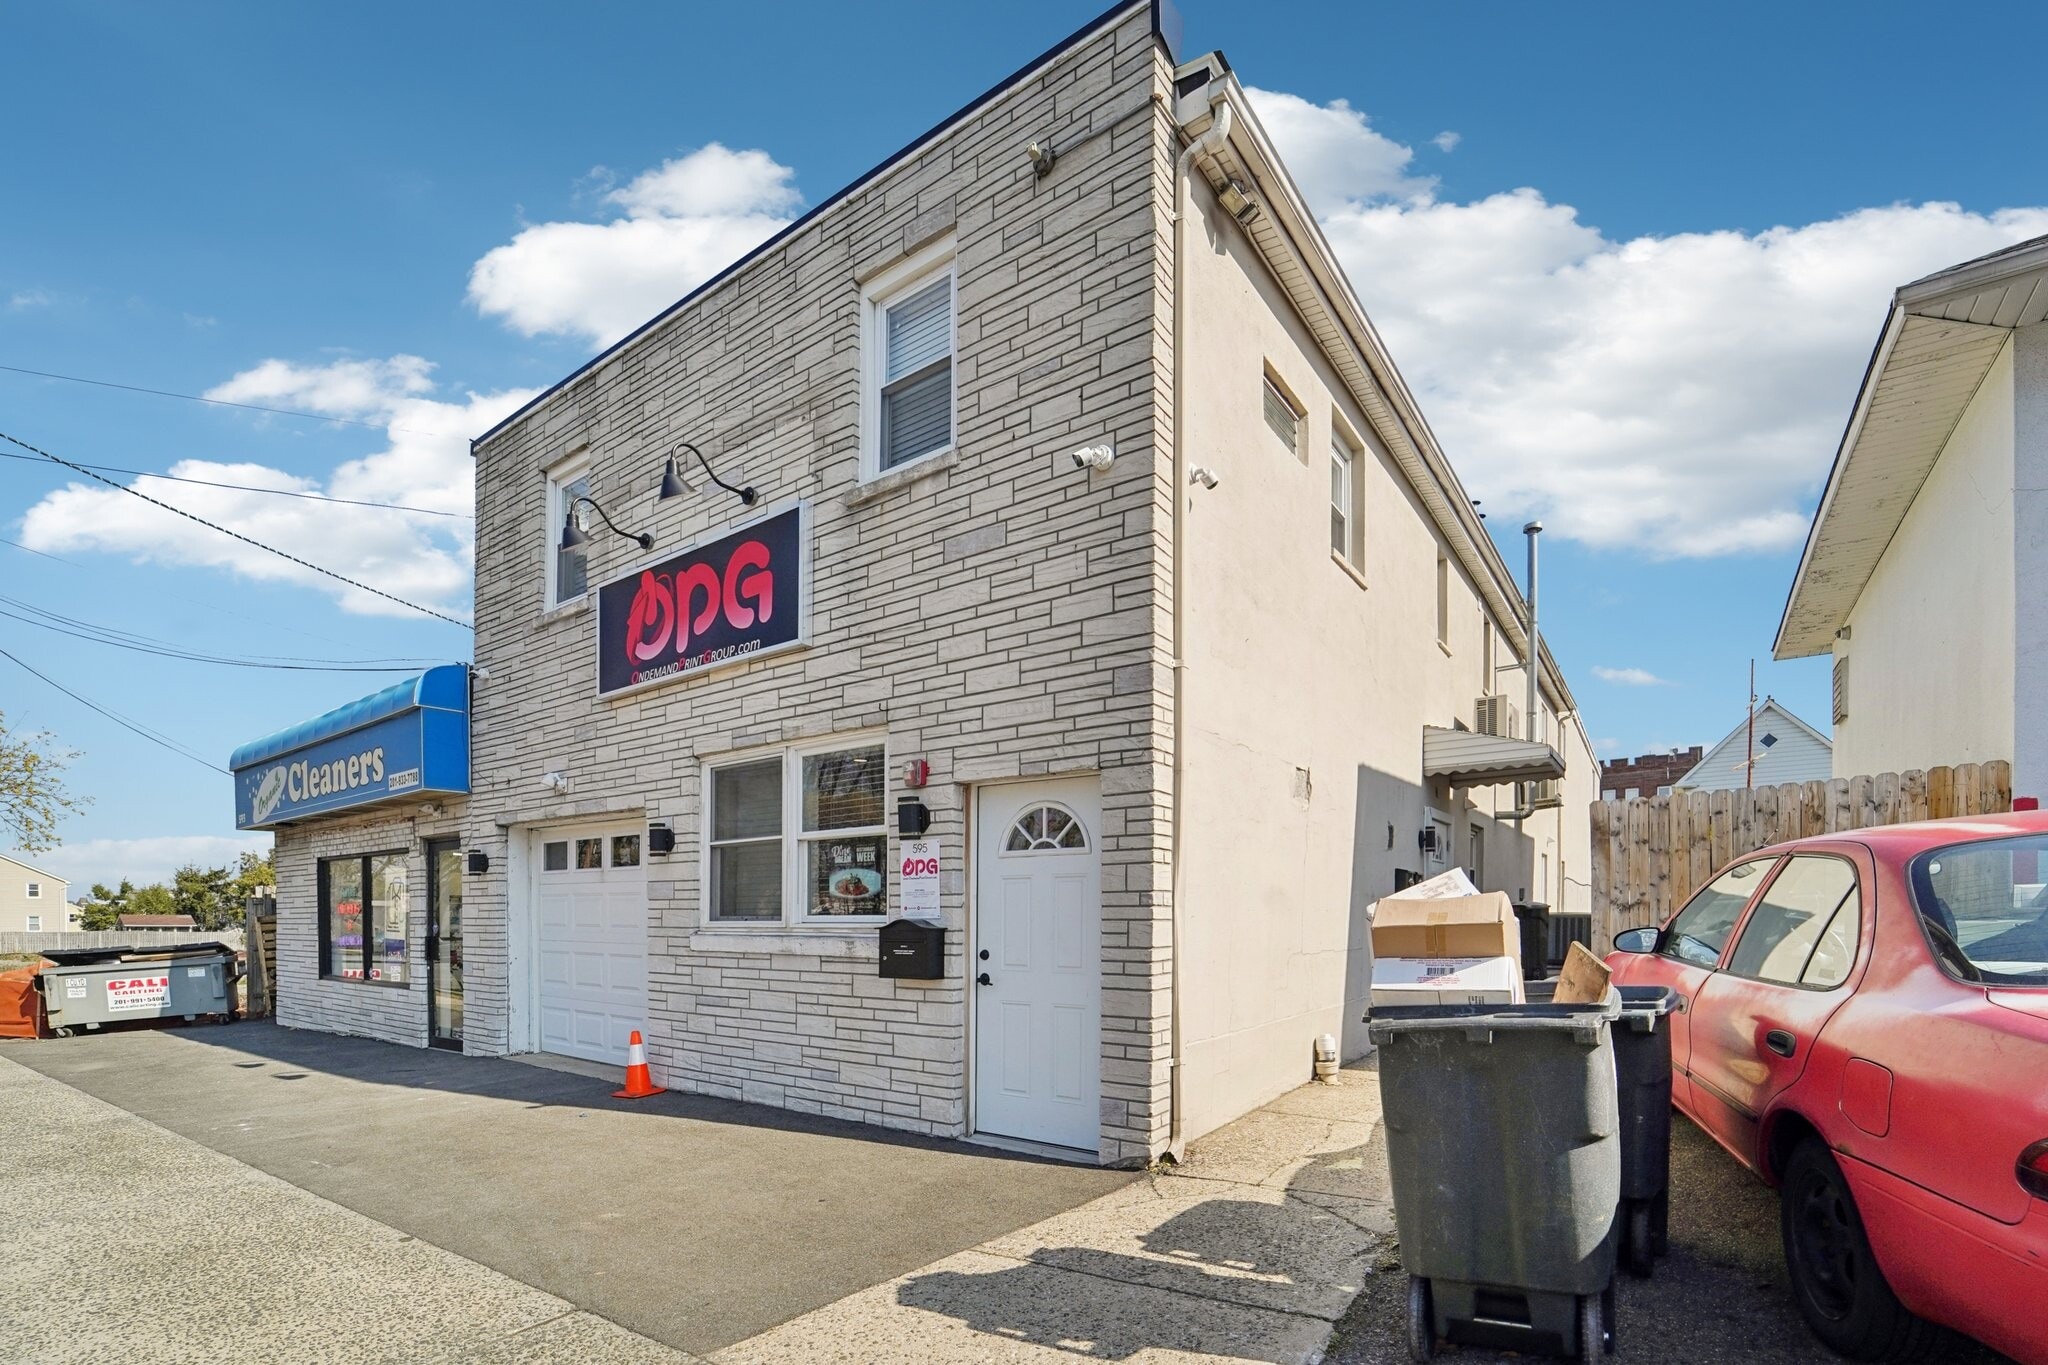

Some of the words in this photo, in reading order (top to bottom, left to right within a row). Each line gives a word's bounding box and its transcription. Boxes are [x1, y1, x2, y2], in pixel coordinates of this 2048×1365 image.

[287, 746, 385, 804] Cleaners
[912, 843, 928, 854] 595
[856, 852, 876, 863] WEEK
[108, 977, 168, 990] CALI
[114, 988, 163, 996] CARTING
